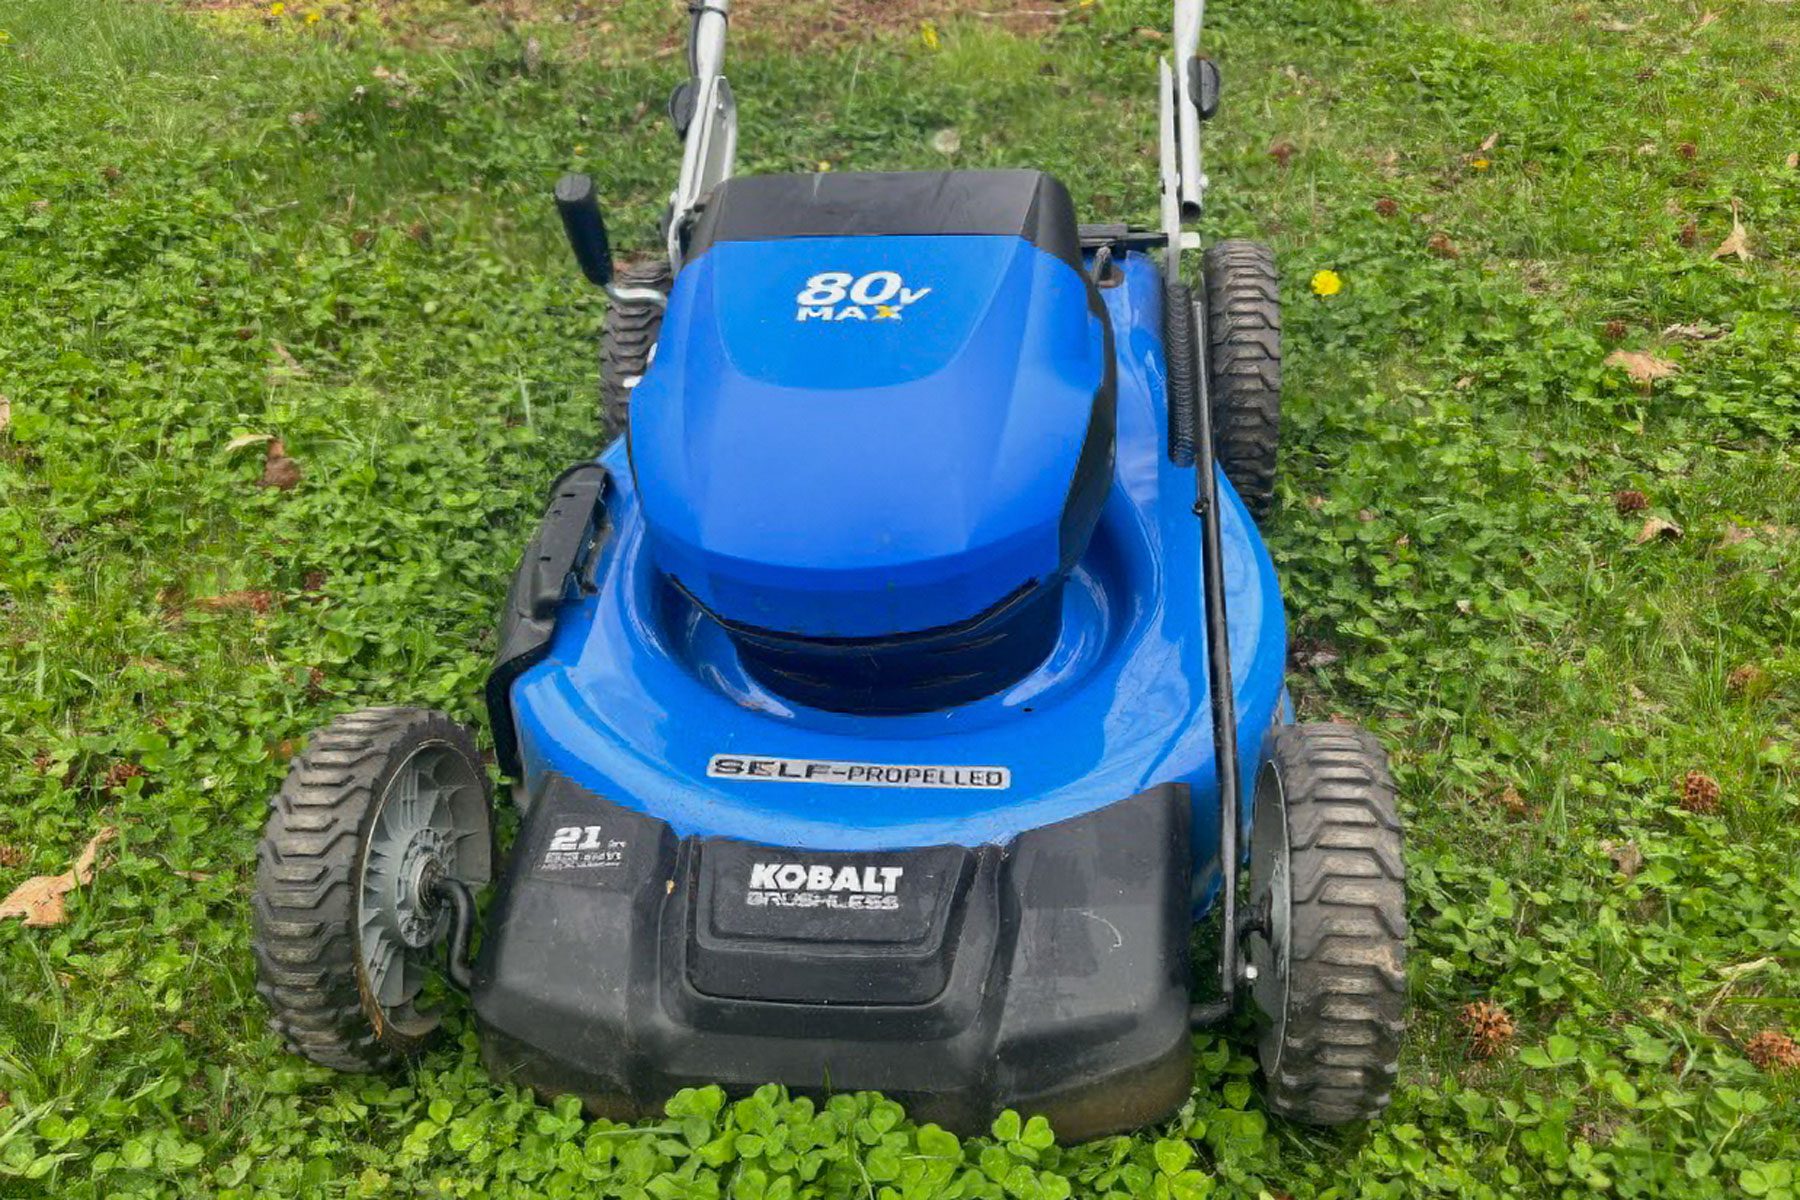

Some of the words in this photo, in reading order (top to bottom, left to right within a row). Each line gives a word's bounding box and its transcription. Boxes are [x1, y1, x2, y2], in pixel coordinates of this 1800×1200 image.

[796, 305, 903, 321] MAX
[714, 758, 1003, 786] SELF-PROPELLED
[549, 826, 601, 850] 21
[750, 863, 903, 893] KOBALT
